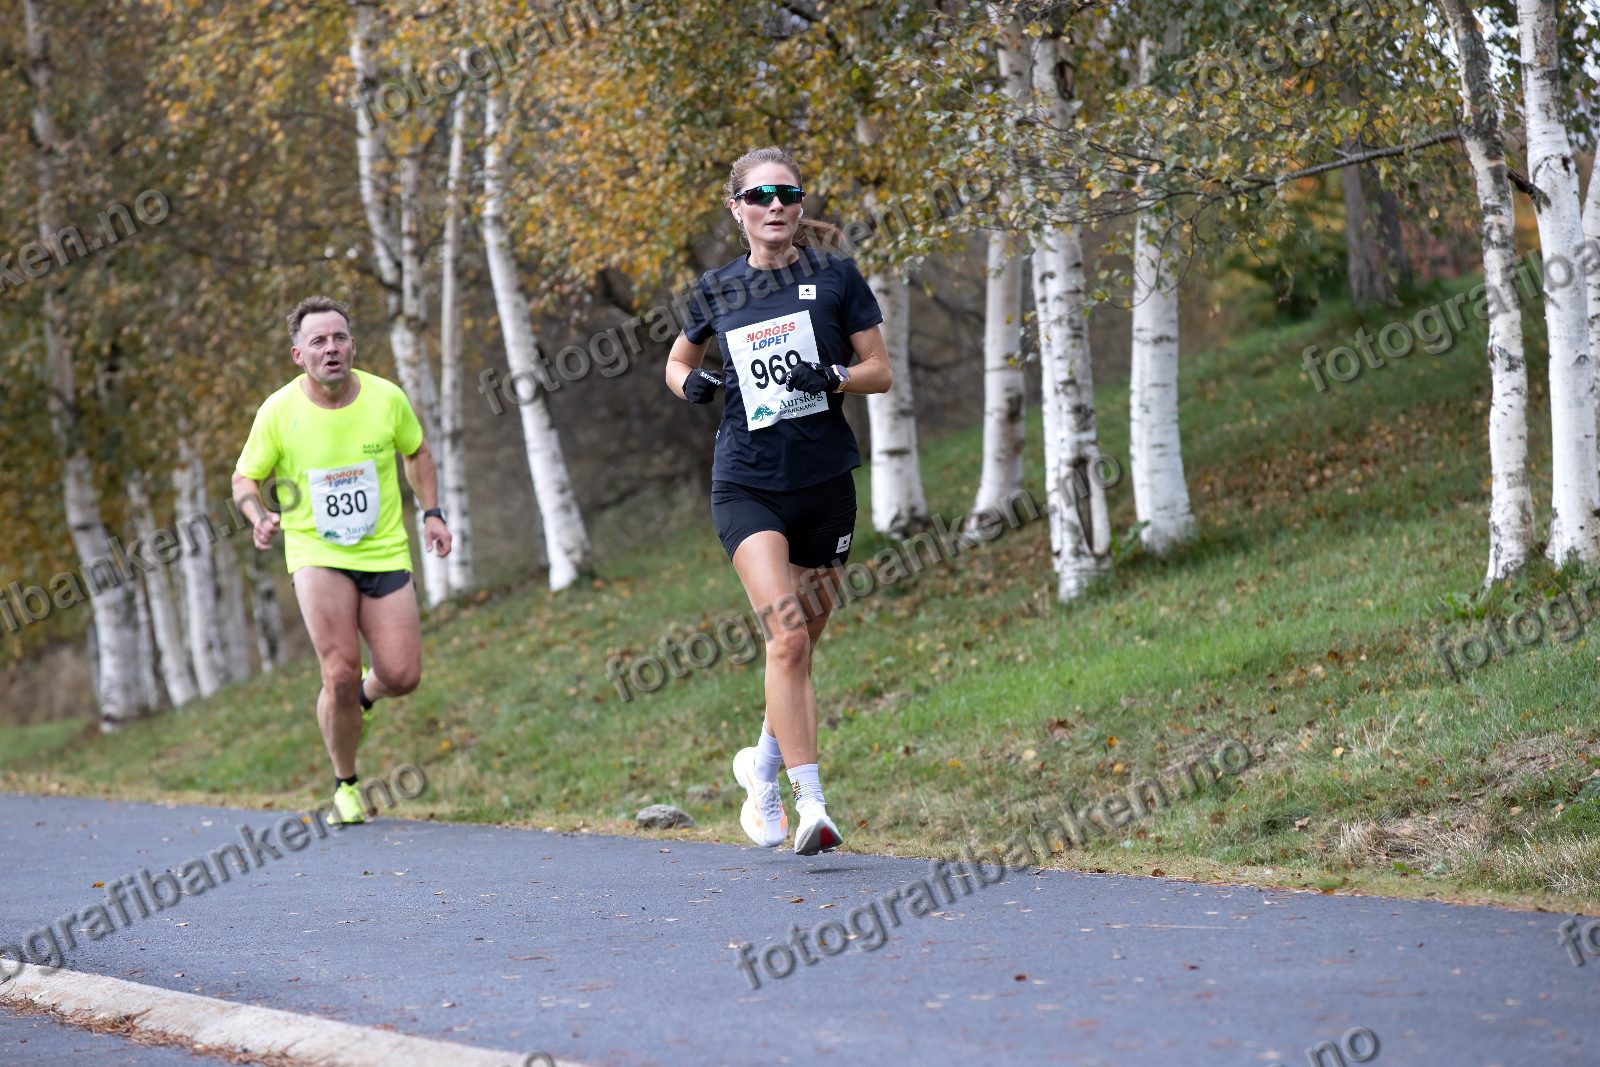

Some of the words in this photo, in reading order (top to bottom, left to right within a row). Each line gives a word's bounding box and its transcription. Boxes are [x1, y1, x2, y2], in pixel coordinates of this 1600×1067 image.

[746, 322, 796, 342] NORGES
[752, 333, 789, 351] LØPET
[326, 469, 365, 481] NORGES
[329, 477, 359, 488] LØPET
[326, 490, 367, 517] 830
